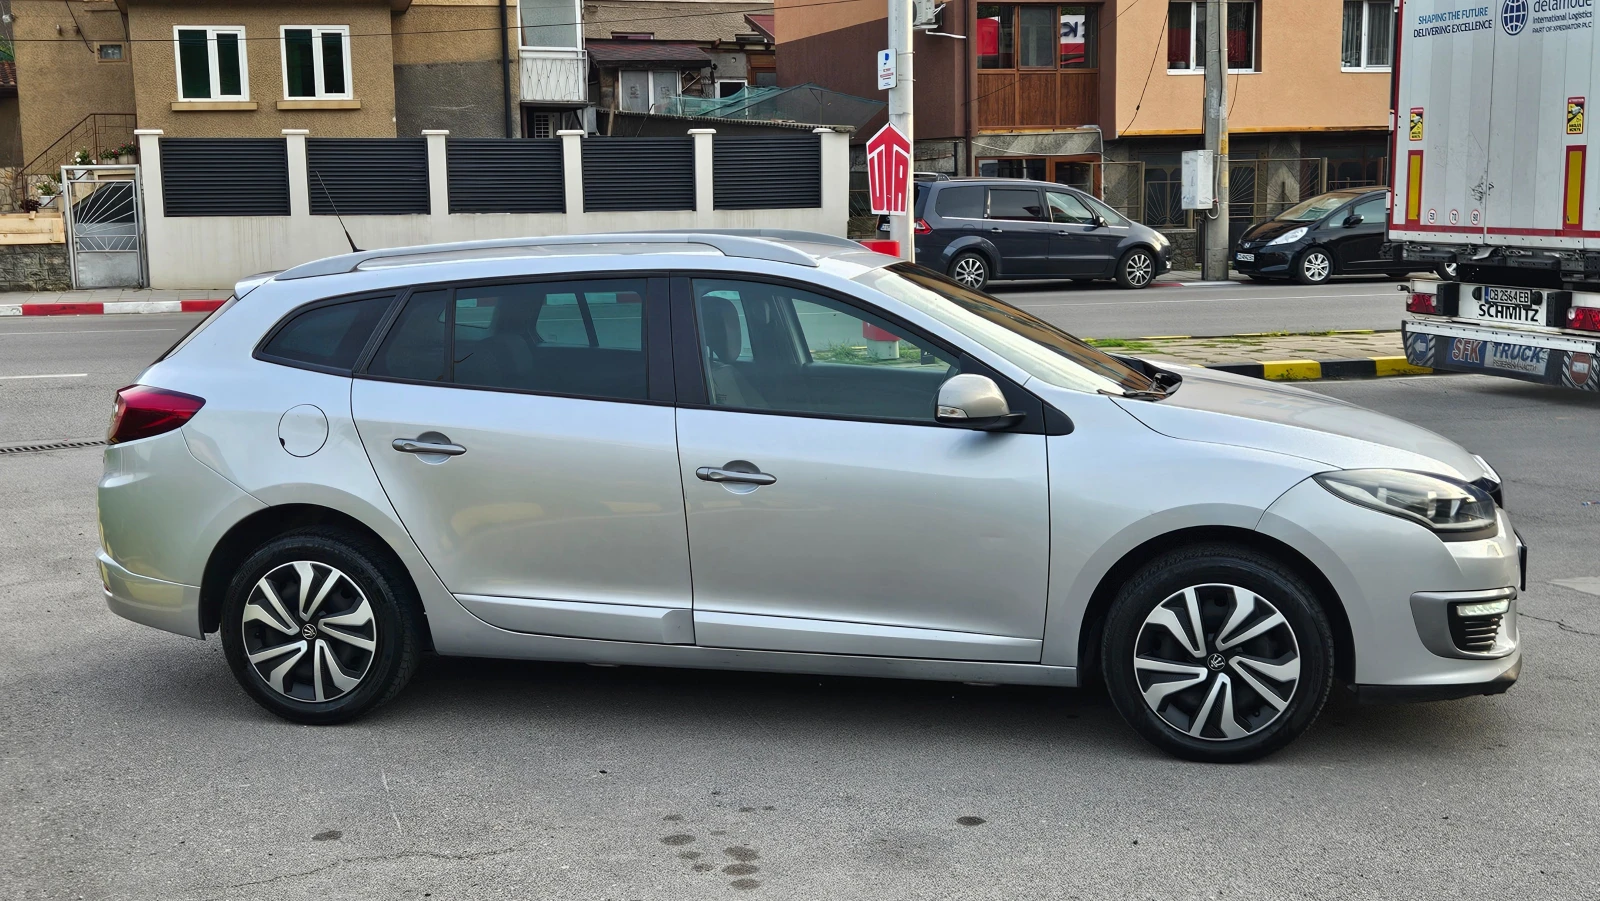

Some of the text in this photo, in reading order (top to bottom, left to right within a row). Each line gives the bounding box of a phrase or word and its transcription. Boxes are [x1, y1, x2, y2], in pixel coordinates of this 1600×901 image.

[1418, 7, 1489, 25] SHAPING THE FUTURE
[1413, 20, 1493, 38] DELIVERING EXCELLENCE
[1478, 303, 1539, 322] SCHMITZ
[1452, 337, 1541, 363] SFK TRUCK
